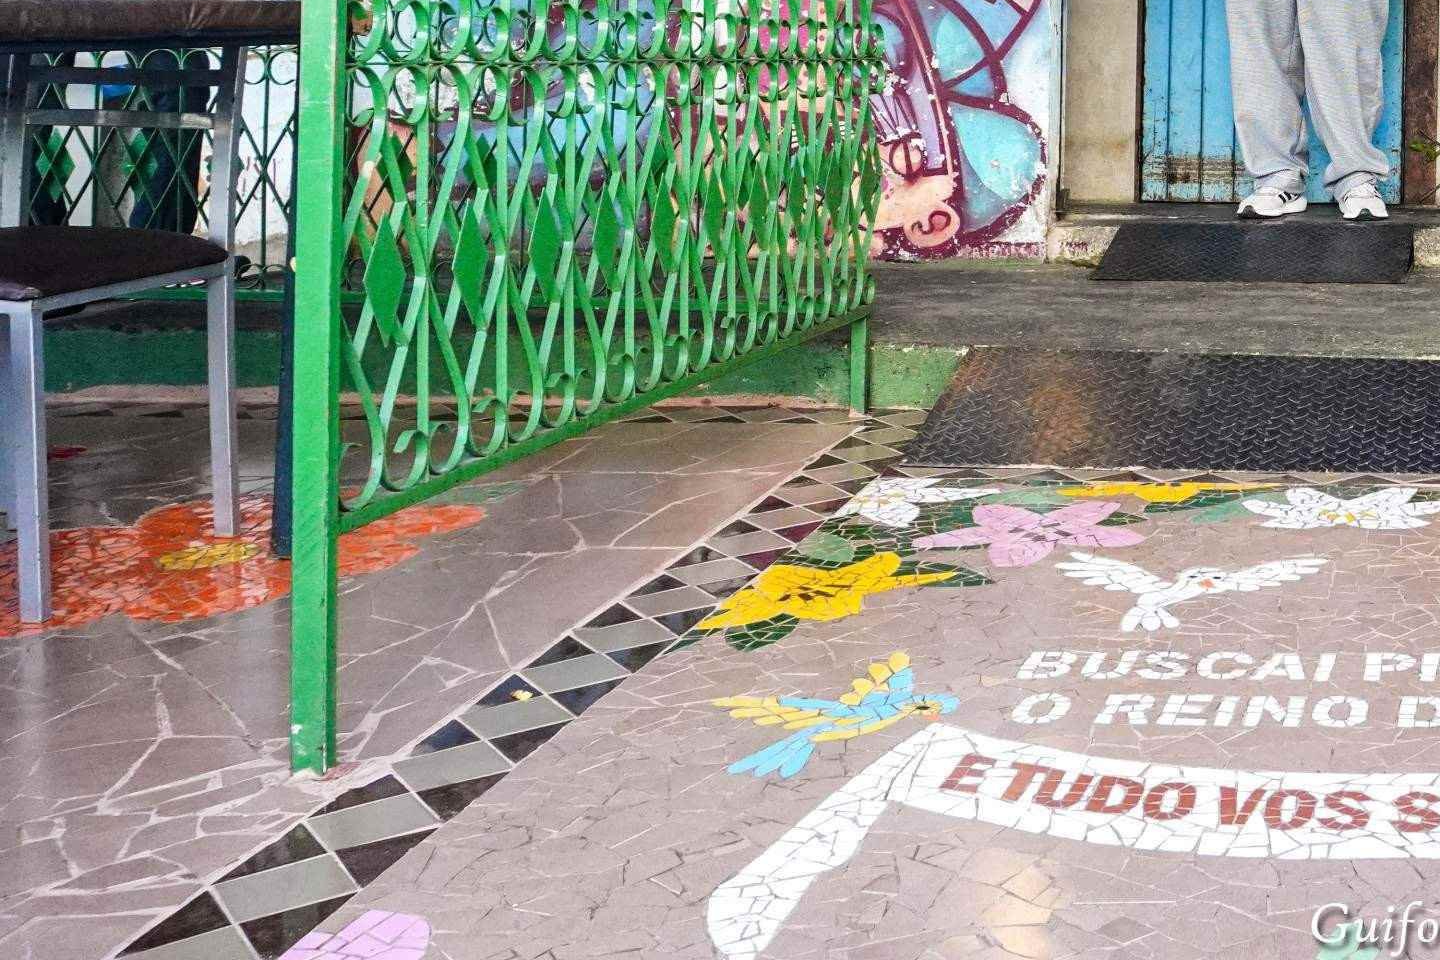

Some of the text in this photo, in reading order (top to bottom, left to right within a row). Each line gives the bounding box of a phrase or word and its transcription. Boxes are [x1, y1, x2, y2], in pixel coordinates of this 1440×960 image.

[1015, 649, 1338, 683] BUSCAI
[1010, 692, 1072, 725] O
[1094, 693, 1370, 729] REINO
[939, 752, 997, 795] E
[1001, 761, 1198, 821] TUDO
[1218, 785, 1377, 832] VOS
